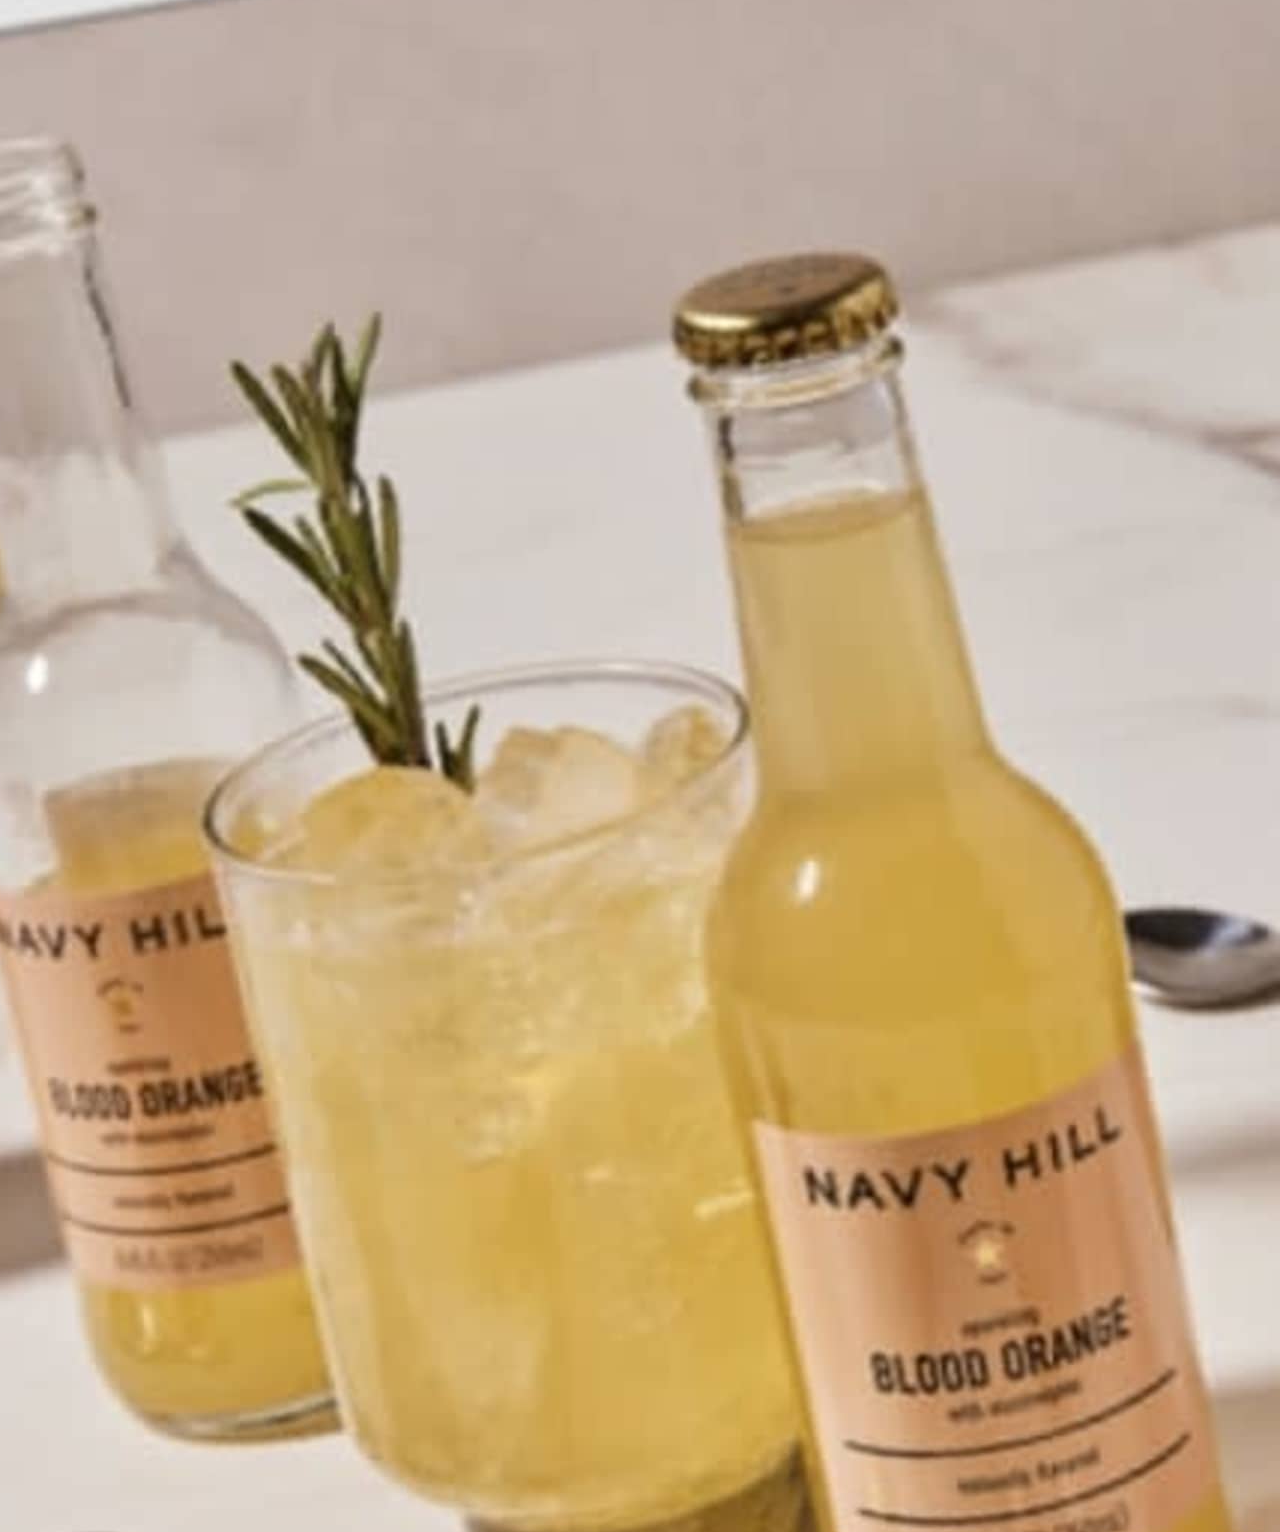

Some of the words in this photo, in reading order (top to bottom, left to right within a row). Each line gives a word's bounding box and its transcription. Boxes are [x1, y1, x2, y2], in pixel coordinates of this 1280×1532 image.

[128, 906, 229, 952] HIL
[138, 1059, 265, 1117] ORANGE
[802, 1157, 971, 1211] NAVY
[1002, 1104, 1125, 1189] HILL
[868, 1346, 989, 1396] BLOOD
[1000, 1295, 1133, 1382] ORANGE
